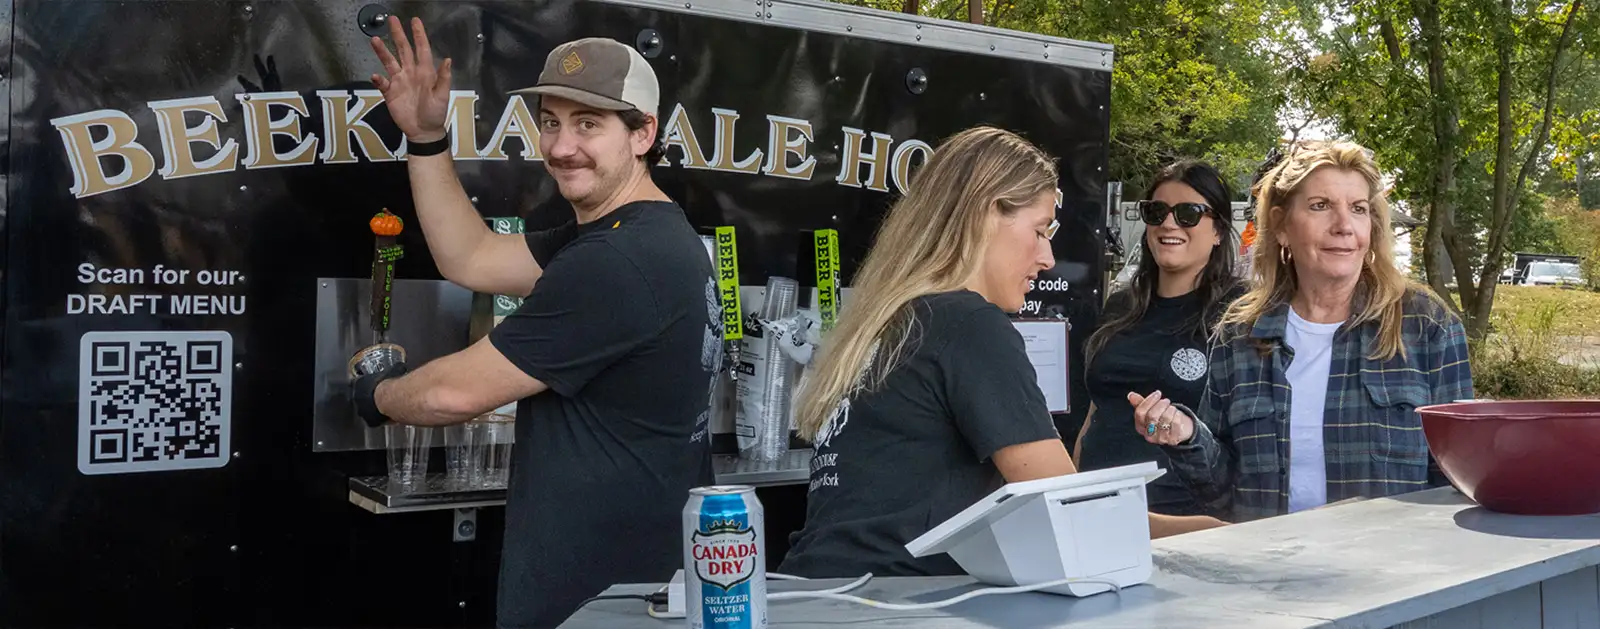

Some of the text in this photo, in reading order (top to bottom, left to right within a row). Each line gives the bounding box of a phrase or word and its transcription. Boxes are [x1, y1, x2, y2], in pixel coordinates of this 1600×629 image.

[50, 90, 541, 199] BEEKMA
[661, 103, 815, 181] ALE
[817, 235, 831, 281] BEER
[77, 263, 239, 286] Scan for our
[718, 232, 739, 335] BEER TREE
[1038, 277, 1069, 291] code
[66, 294, 246, 315] DRAFT MENU
[1019, 300, 1042, 315] pay
[692, 543, 758, 560] CANADA
[708, 560, 744, 576] DRY
[704, 594, 749, 605] SELTZER
[709, 604, 745, 615] WATER
